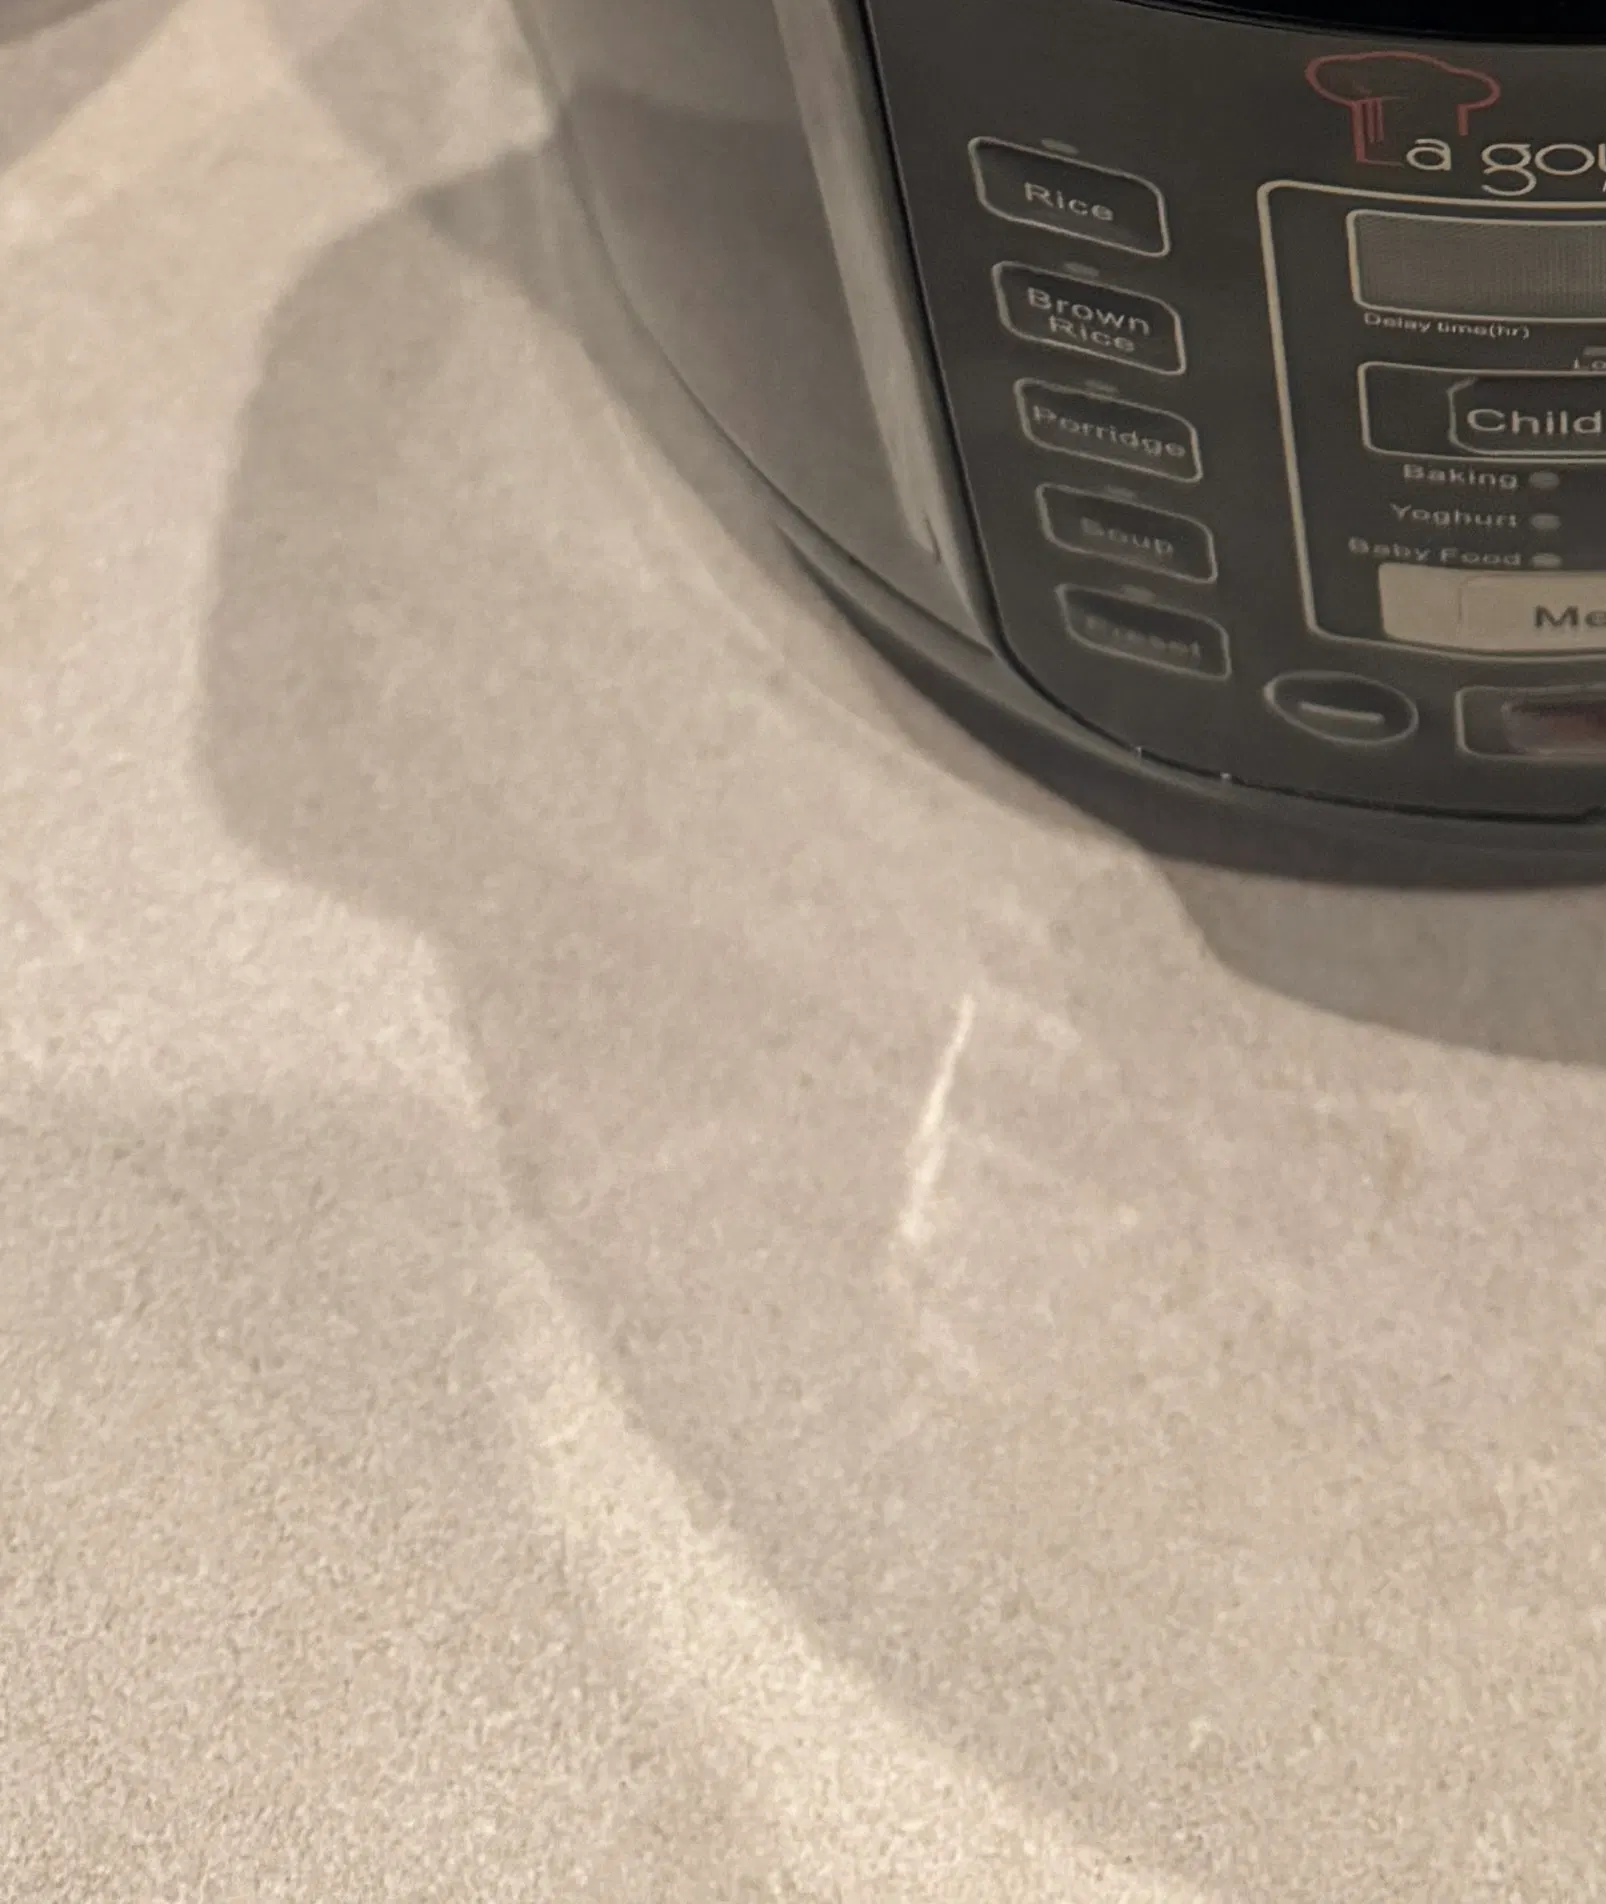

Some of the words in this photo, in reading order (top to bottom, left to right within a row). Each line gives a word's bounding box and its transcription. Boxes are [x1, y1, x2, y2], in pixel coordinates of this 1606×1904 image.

[1023, 181, 1115, 222] Rice
[1026, 286, 1151, 336] Brown
[1363, 311, 1432, 335] Delay
[1048, 314, 1136, 354] Rice
[1031, 404, 1187, 458] Porridge
[1465, 407, 1603, 437] Child
[1402, 462, 1520, 490] Baking
[1389, 503, 1518, 531] Yoghurt
[1439, 547, 1523, 569] Food
